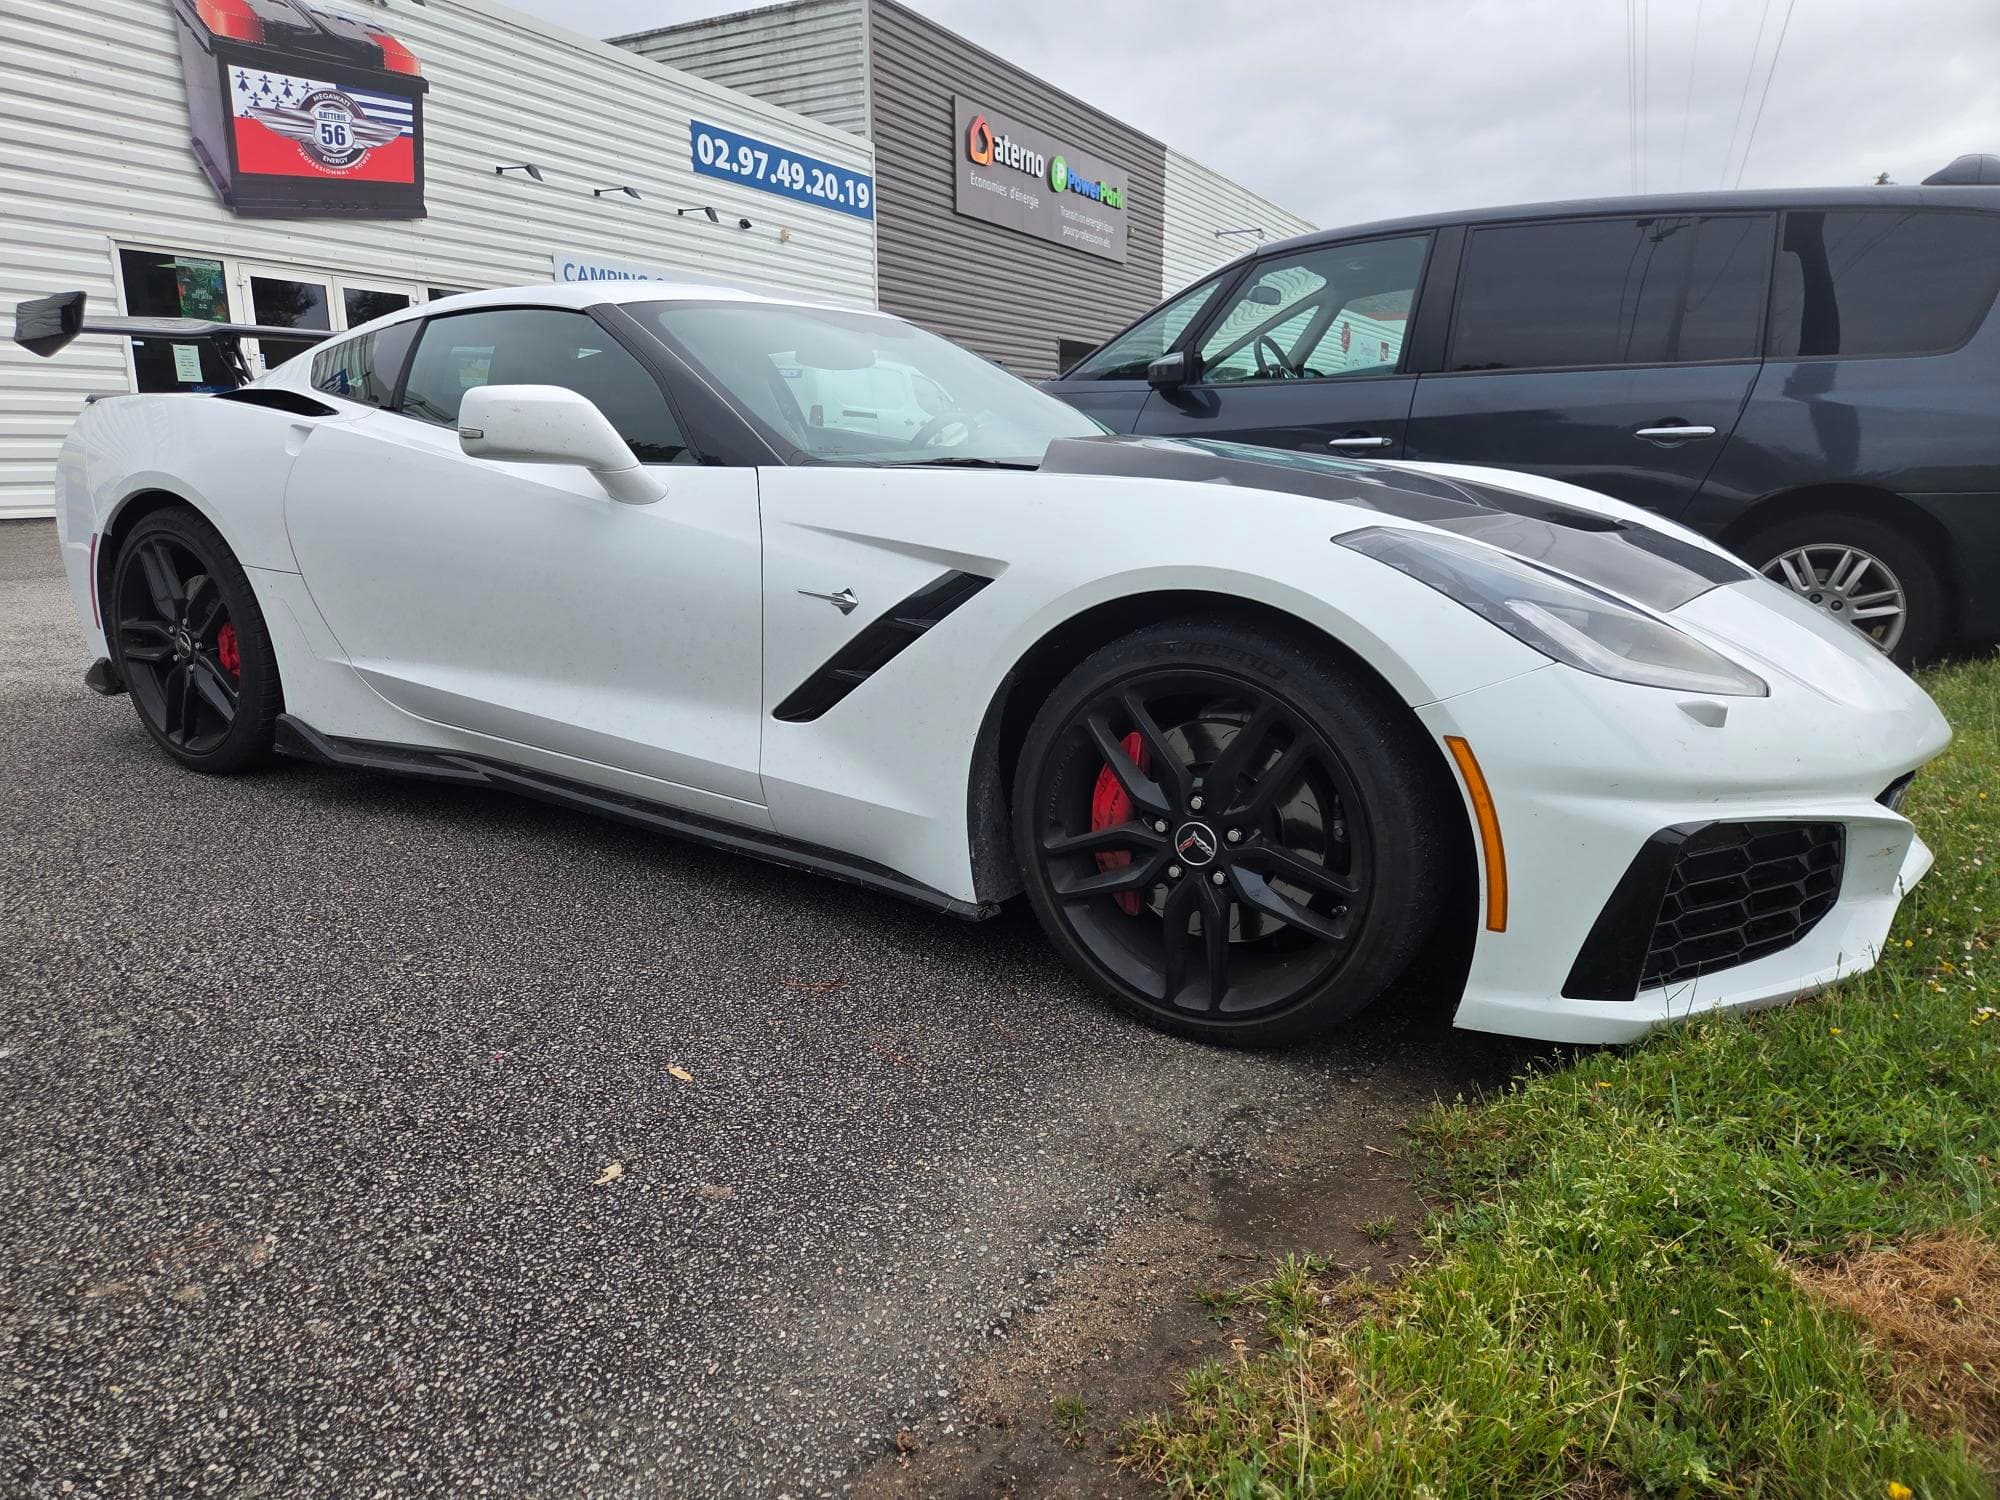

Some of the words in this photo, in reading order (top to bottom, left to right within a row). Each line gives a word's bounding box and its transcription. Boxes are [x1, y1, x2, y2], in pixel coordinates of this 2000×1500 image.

[312, 93, 351, 107] MEGAWATT
[318, 111, 347, 121] BATTERIE
[321, 123, 346, 146] 56
[322, 155, 348, 165] ENERGY
[355, 152, 371, 170] POWER
[994, 135, 1045, 178] aterno
[697, 133, 870, 209] 02.97.49.20.19
[970, 172, 1008, 196] Économies
[1067, 167, 1123, 209] PowerPark
[563, 262, 648, 281] CAMP
